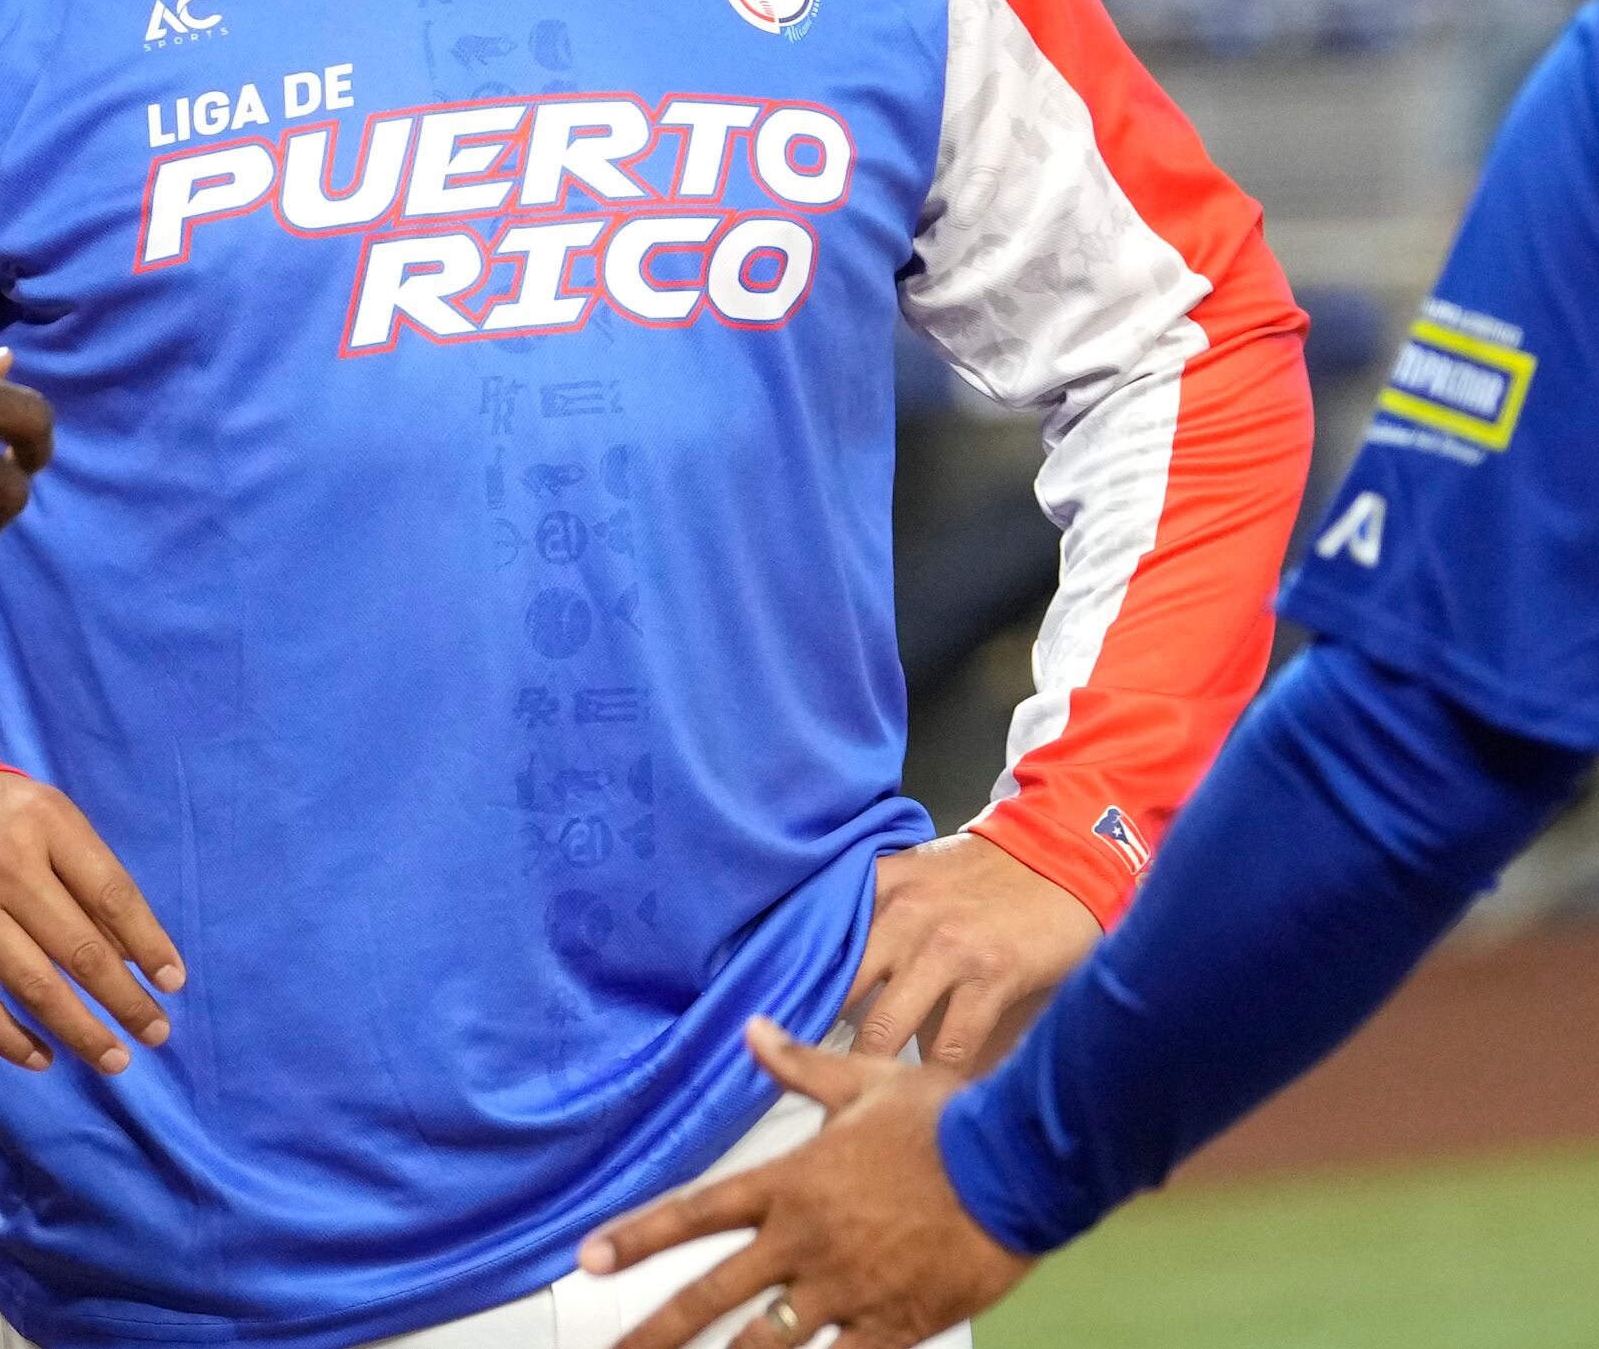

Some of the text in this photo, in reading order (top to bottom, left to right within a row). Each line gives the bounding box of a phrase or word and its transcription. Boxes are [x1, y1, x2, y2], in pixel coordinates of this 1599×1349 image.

[143, 26, 229, 52] SPORTS
[147, 63, 354, 148] LIGA DE
[136, 94, 856, 272] PUERTO
[341, 210, 818, 357] RICO
